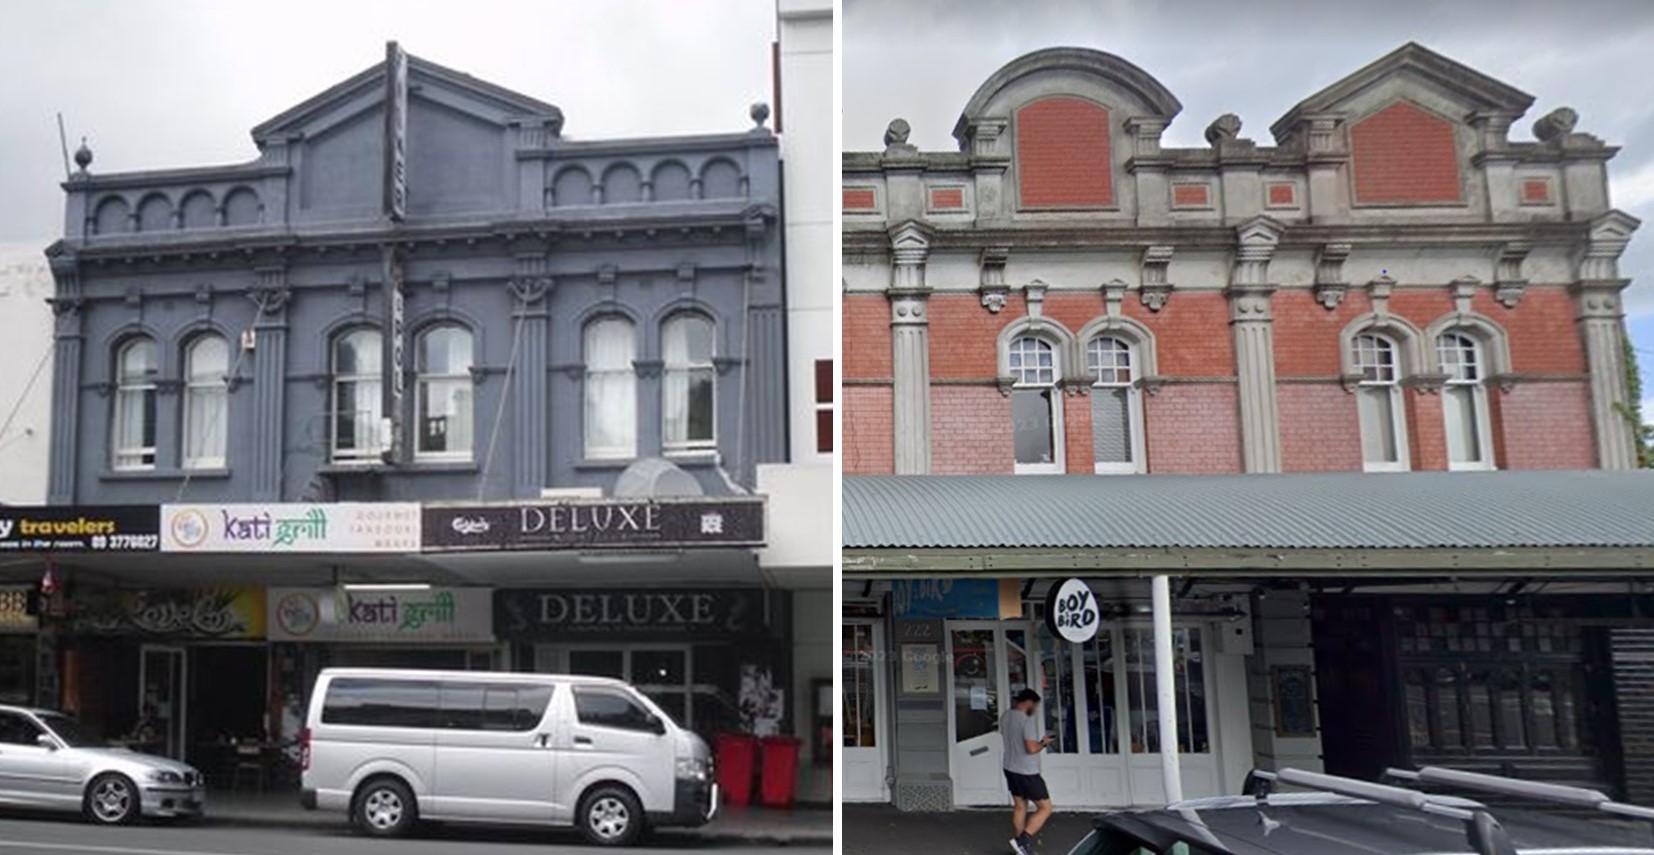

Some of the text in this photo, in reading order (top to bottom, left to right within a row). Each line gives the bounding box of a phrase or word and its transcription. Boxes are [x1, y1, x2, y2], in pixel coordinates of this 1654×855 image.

[20, 517, 116, 534] travelers
[221, 508, 328, 546] kati grill
[520, 504, 662, 533] DELUXE
[349, 590, 455, 630] kati grill
[540, 594, 717, 624] DELUXE
[1058, 590, 1089, 614] BOY
[904, 623, 932, 637] 222
